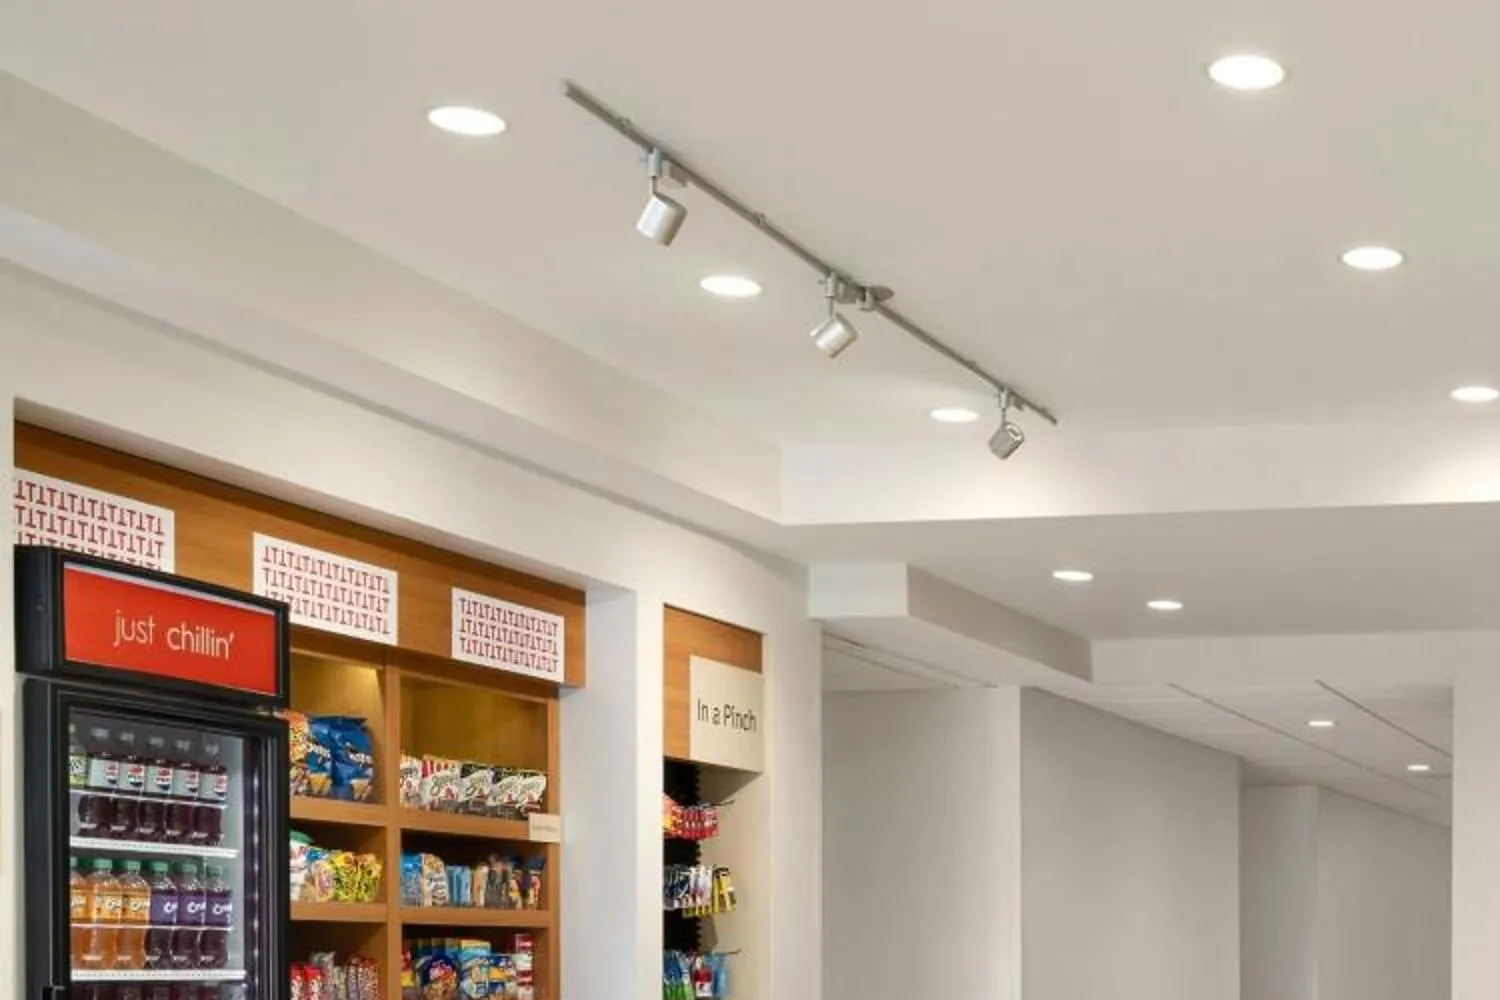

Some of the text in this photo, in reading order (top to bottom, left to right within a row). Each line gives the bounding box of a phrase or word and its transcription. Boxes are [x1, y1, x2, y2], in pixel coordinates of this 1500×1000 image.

[113, 608, 156, 647] just
[697, 698, 757, 733] In a Pinch
